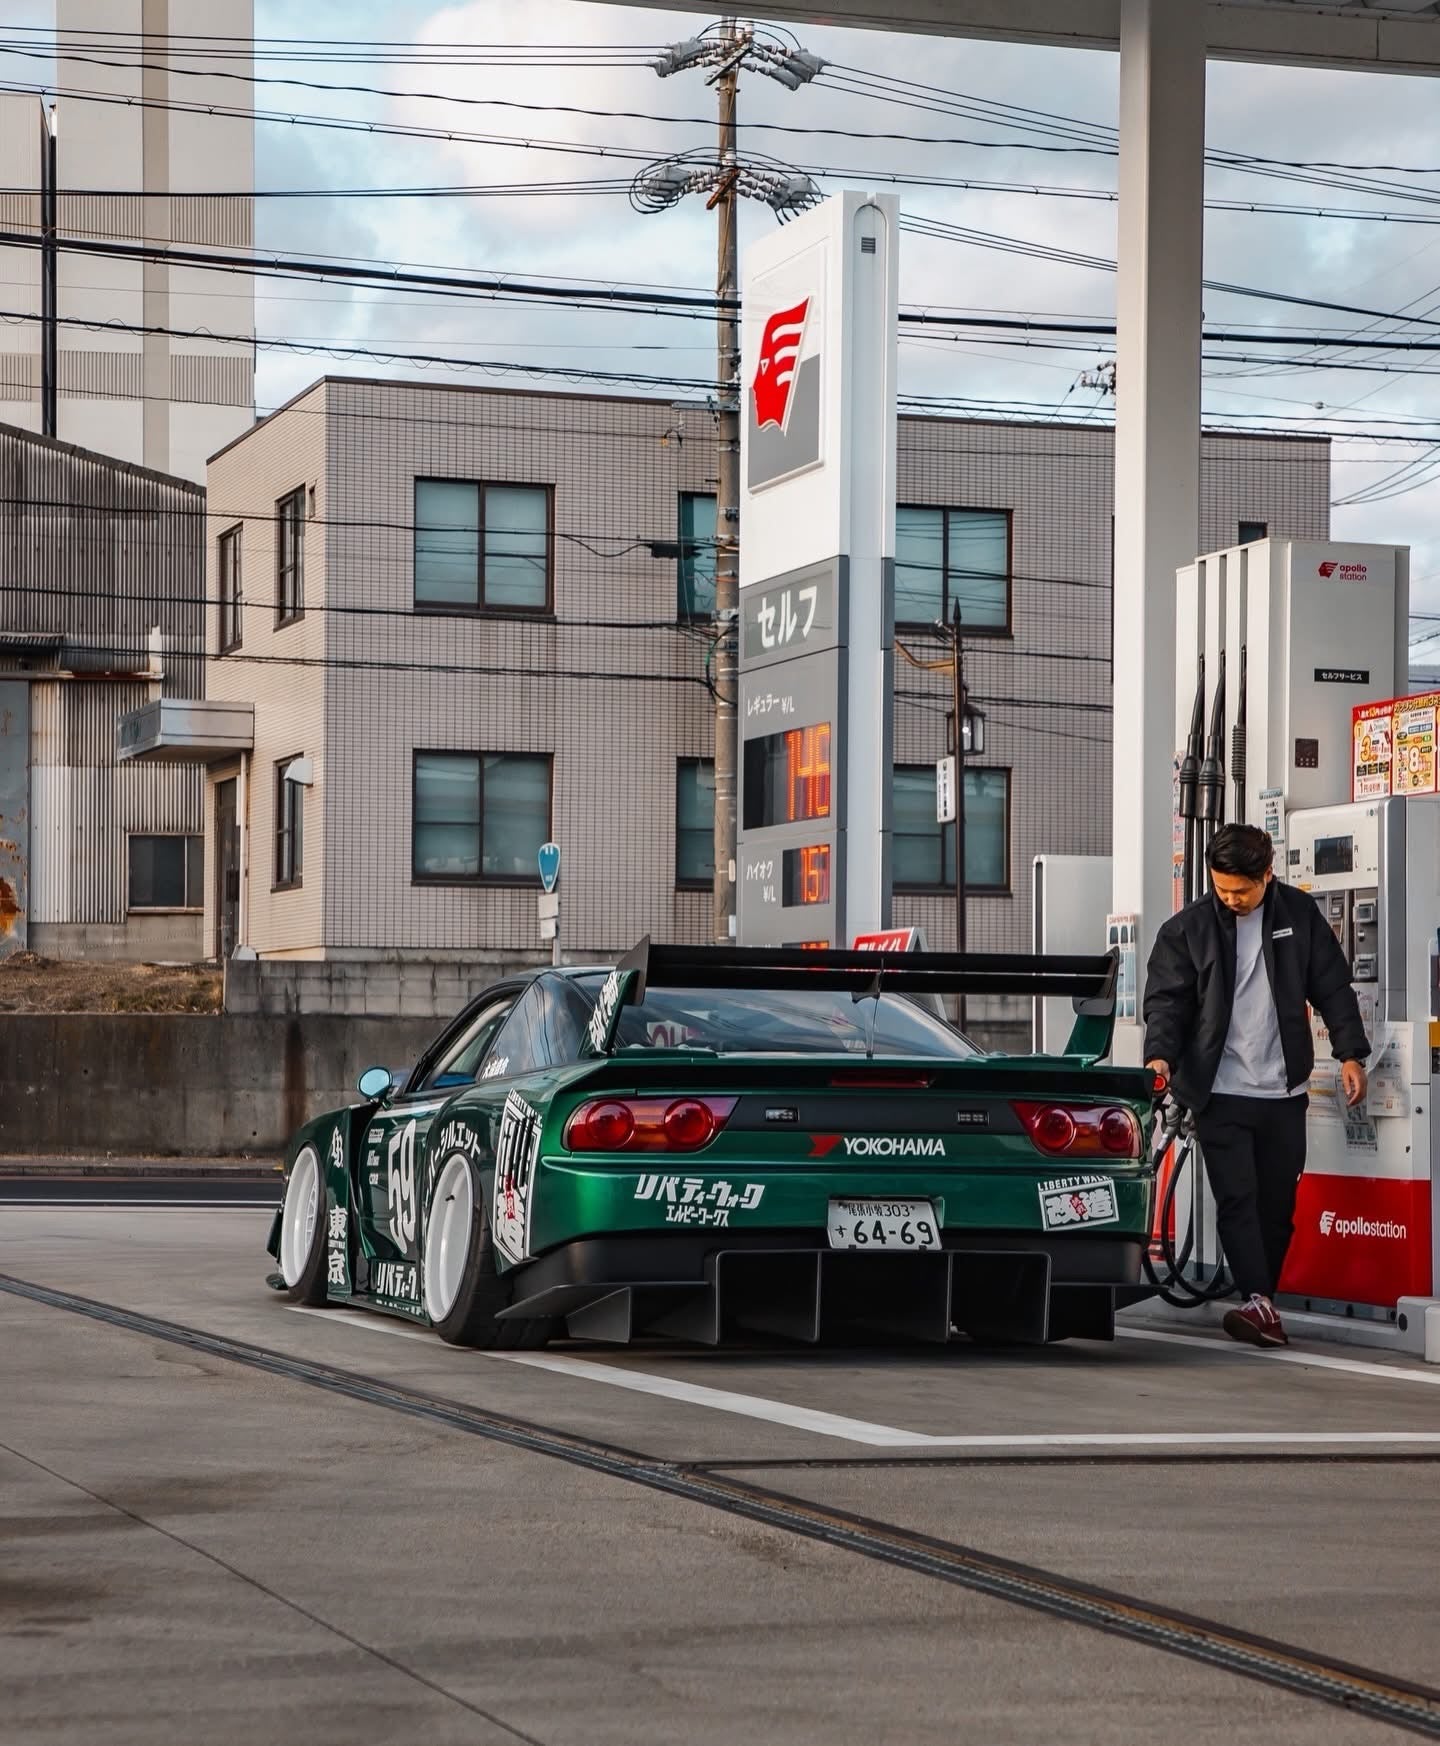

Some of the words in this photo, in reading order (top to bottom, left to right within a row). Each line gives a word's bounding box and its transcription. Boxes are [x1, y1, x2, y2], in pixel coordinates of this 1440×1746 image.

[1339, 564, 1367, 574] apollo
[1339, 572, 1367, 581] station
[757, 585, 816, 648] セルフ
[1321, 672, 1363, 681] セルフサービス
[747, 694, 780, 717] レギュラー
[781, 695, 795, 714] ¥/L
[746, 861, 773, 881] ハイオク
[763, 885, 776, 902] ¥/L
[843, 1138, 946, 1156] YOKOHAMA
[387, 1118, 416, 1254] 59
[633, 1173, 766, 1210] リバティーウォーク
[1037, 1176, 1080, 1191] LIBERTY
[853, 1220, 934, 1245] 64-69
[1335, 1216, 1407, 1239] apollostation
[327, 1204, 349, 1286] 東京
